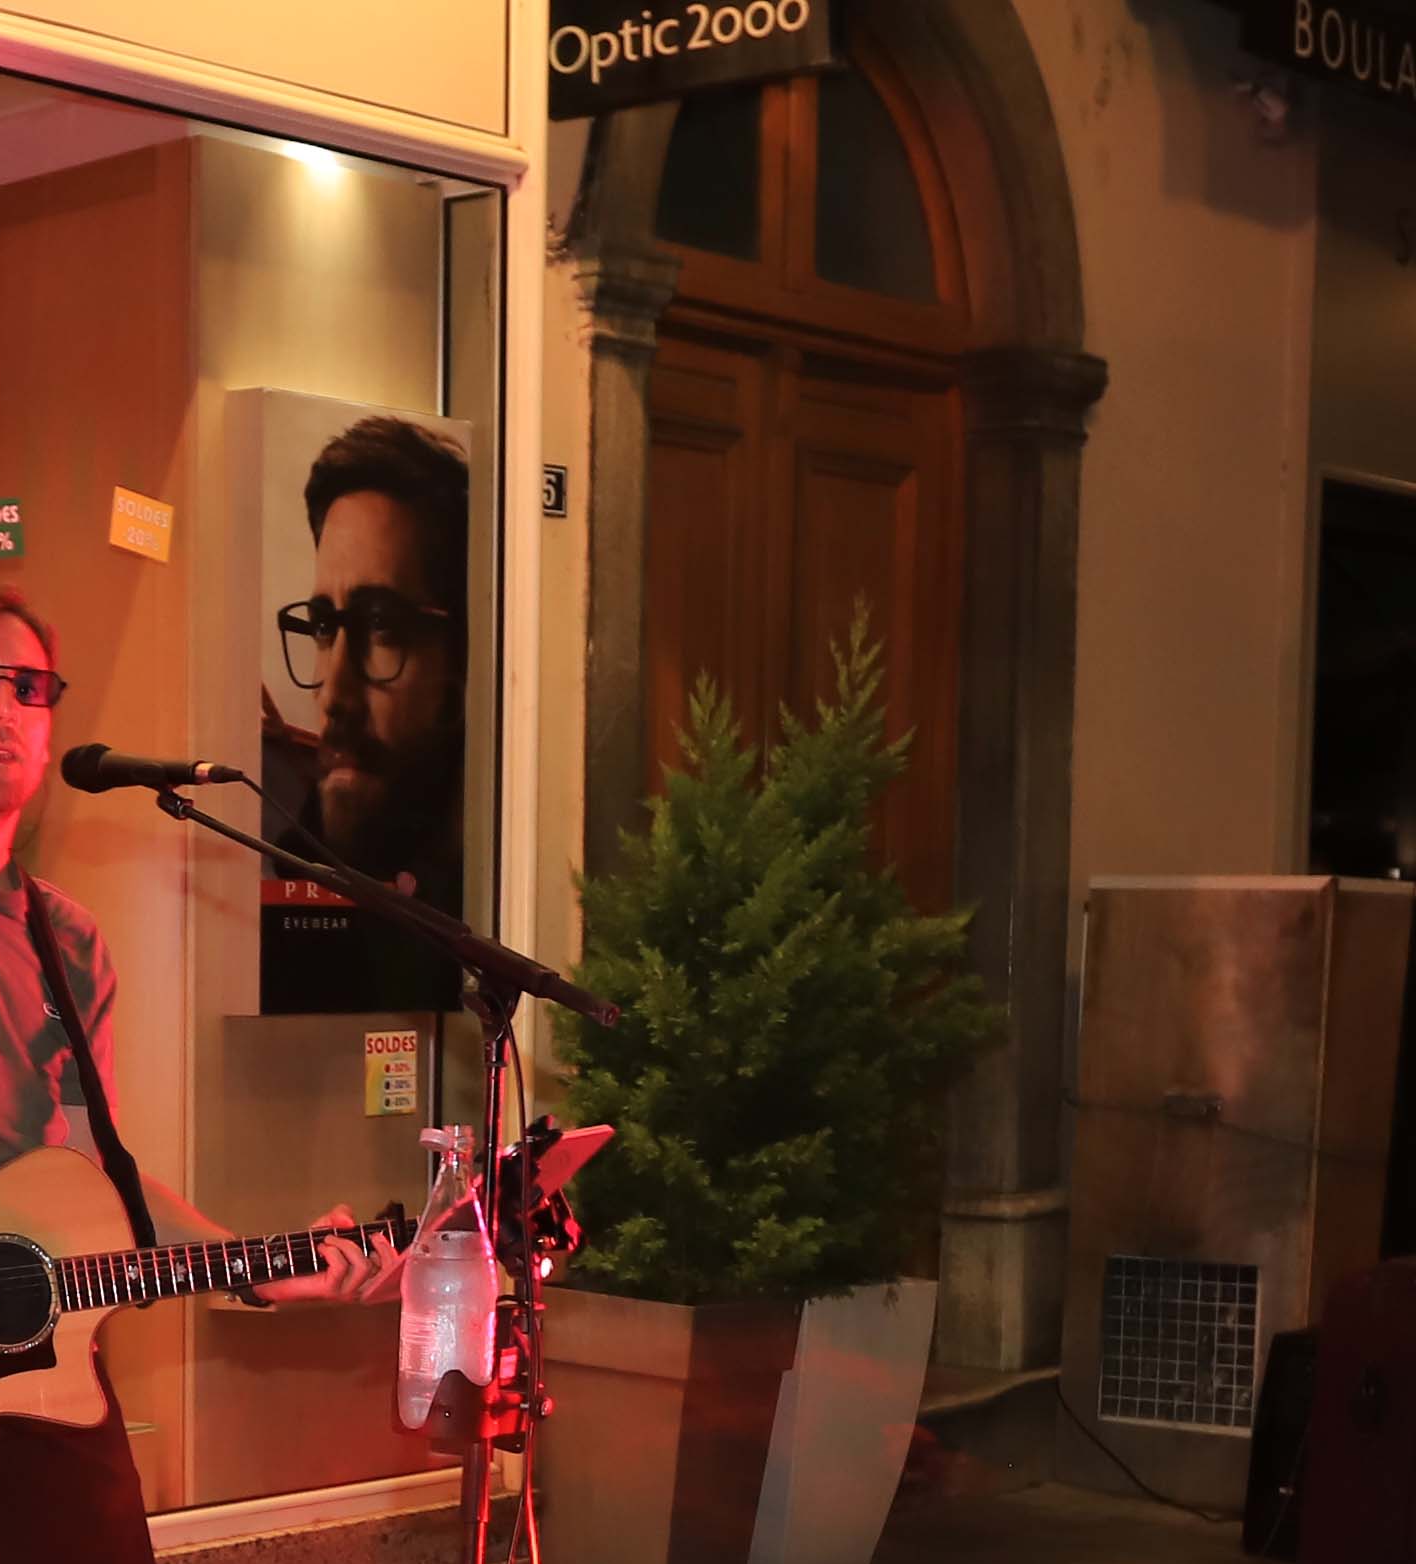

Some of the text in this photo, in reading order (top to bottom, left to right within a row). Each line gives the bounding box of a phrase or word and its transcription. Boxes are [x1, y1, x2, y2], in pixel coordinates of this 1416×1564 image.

[548, 0, 810, 84] Optic 2000
[118, 496, 169, 529] SOLDES
[283, 917, 349, 929] EYEWEAR
[367, 1035, 416, 1054] SOLDES
